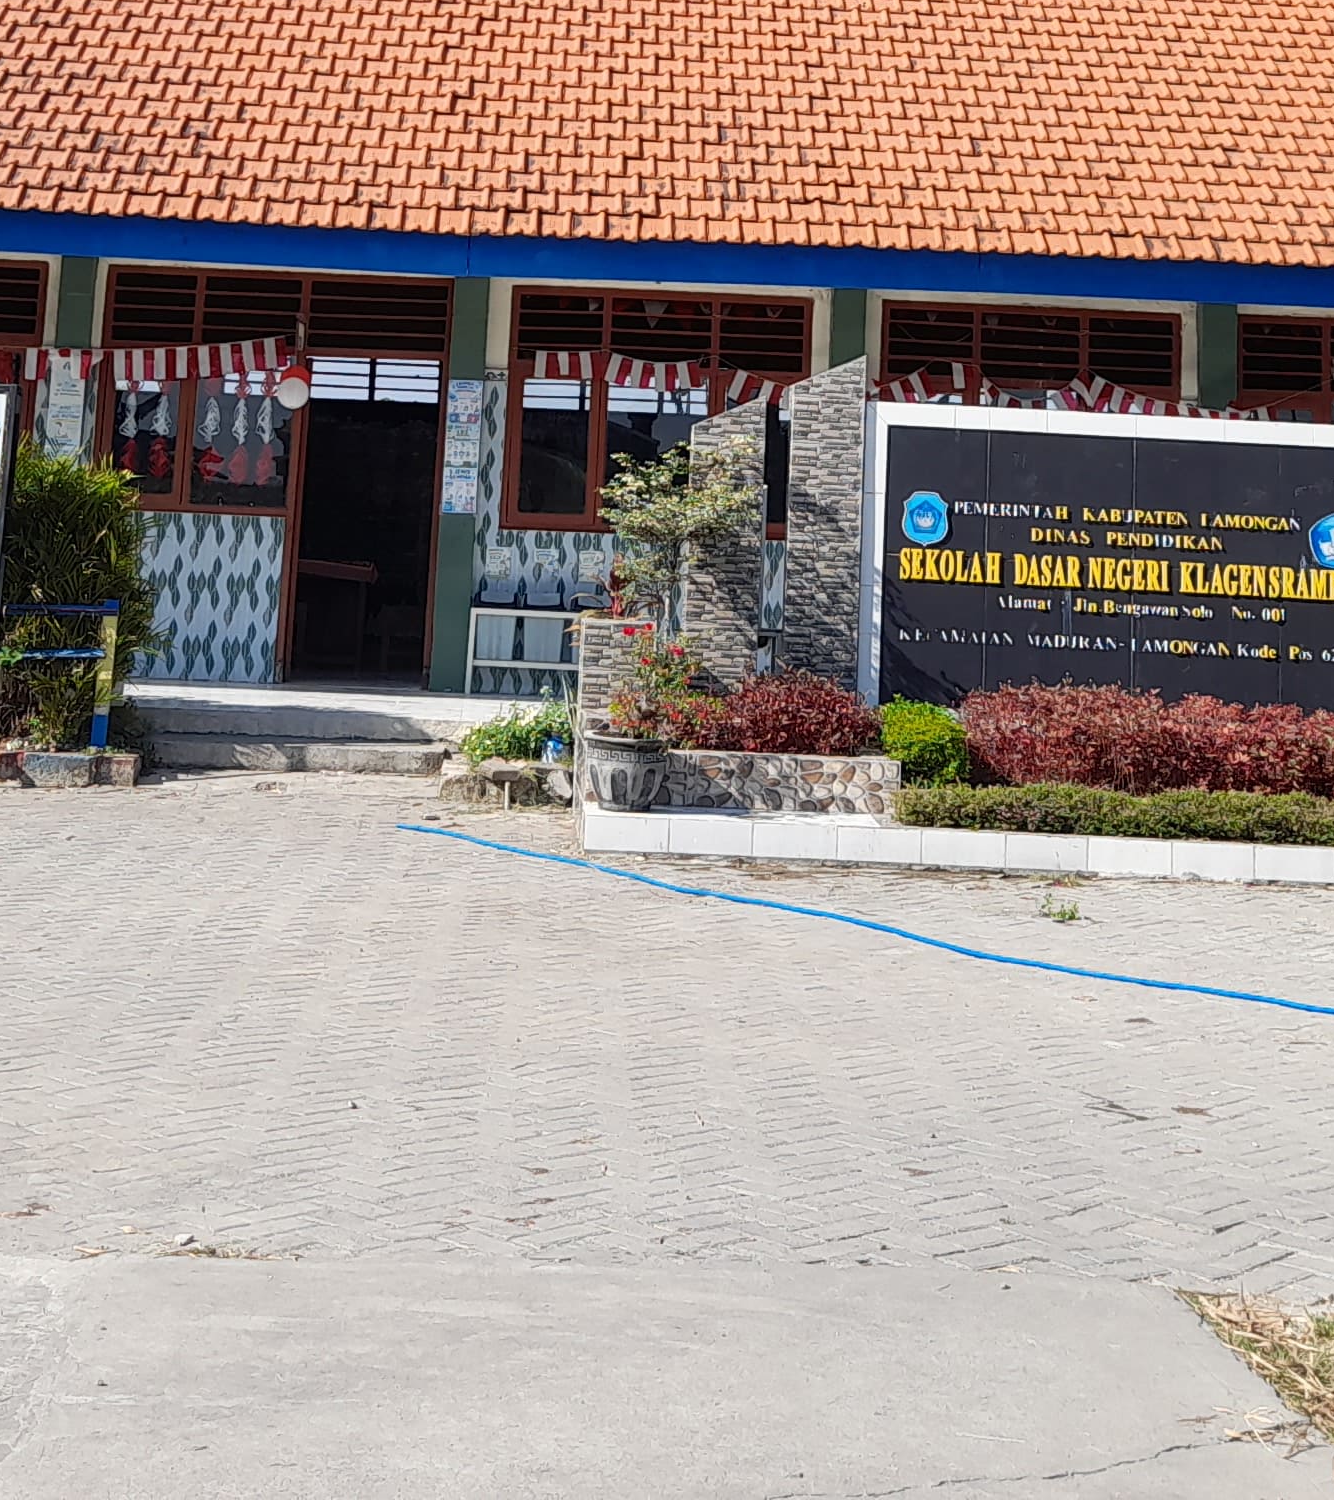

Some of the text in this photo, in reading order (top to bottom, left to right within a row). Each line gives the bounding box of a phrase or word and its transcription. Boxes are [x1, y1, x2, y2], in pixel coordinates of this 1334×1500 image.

[954, 501, 1301, 531] PEMERINTAH KABUPATEN LAMONGAN
[1031, 527, 1223, 550] DINAS PENDIDIKAN
[900, 548, 1002, 584] SEKOLAH
[1014, 553, 1081, 588] DASAR
[1088, 557, 1170, 592] NEGERI
[999, 595, 1051, 611] Alamat
[1231, 606, 1255, 620] No.
[1261, 608, 1285, 622] 001
[1237, 643, 1277, 659] Kode
[1289, 645, 1313, 661] Pos
